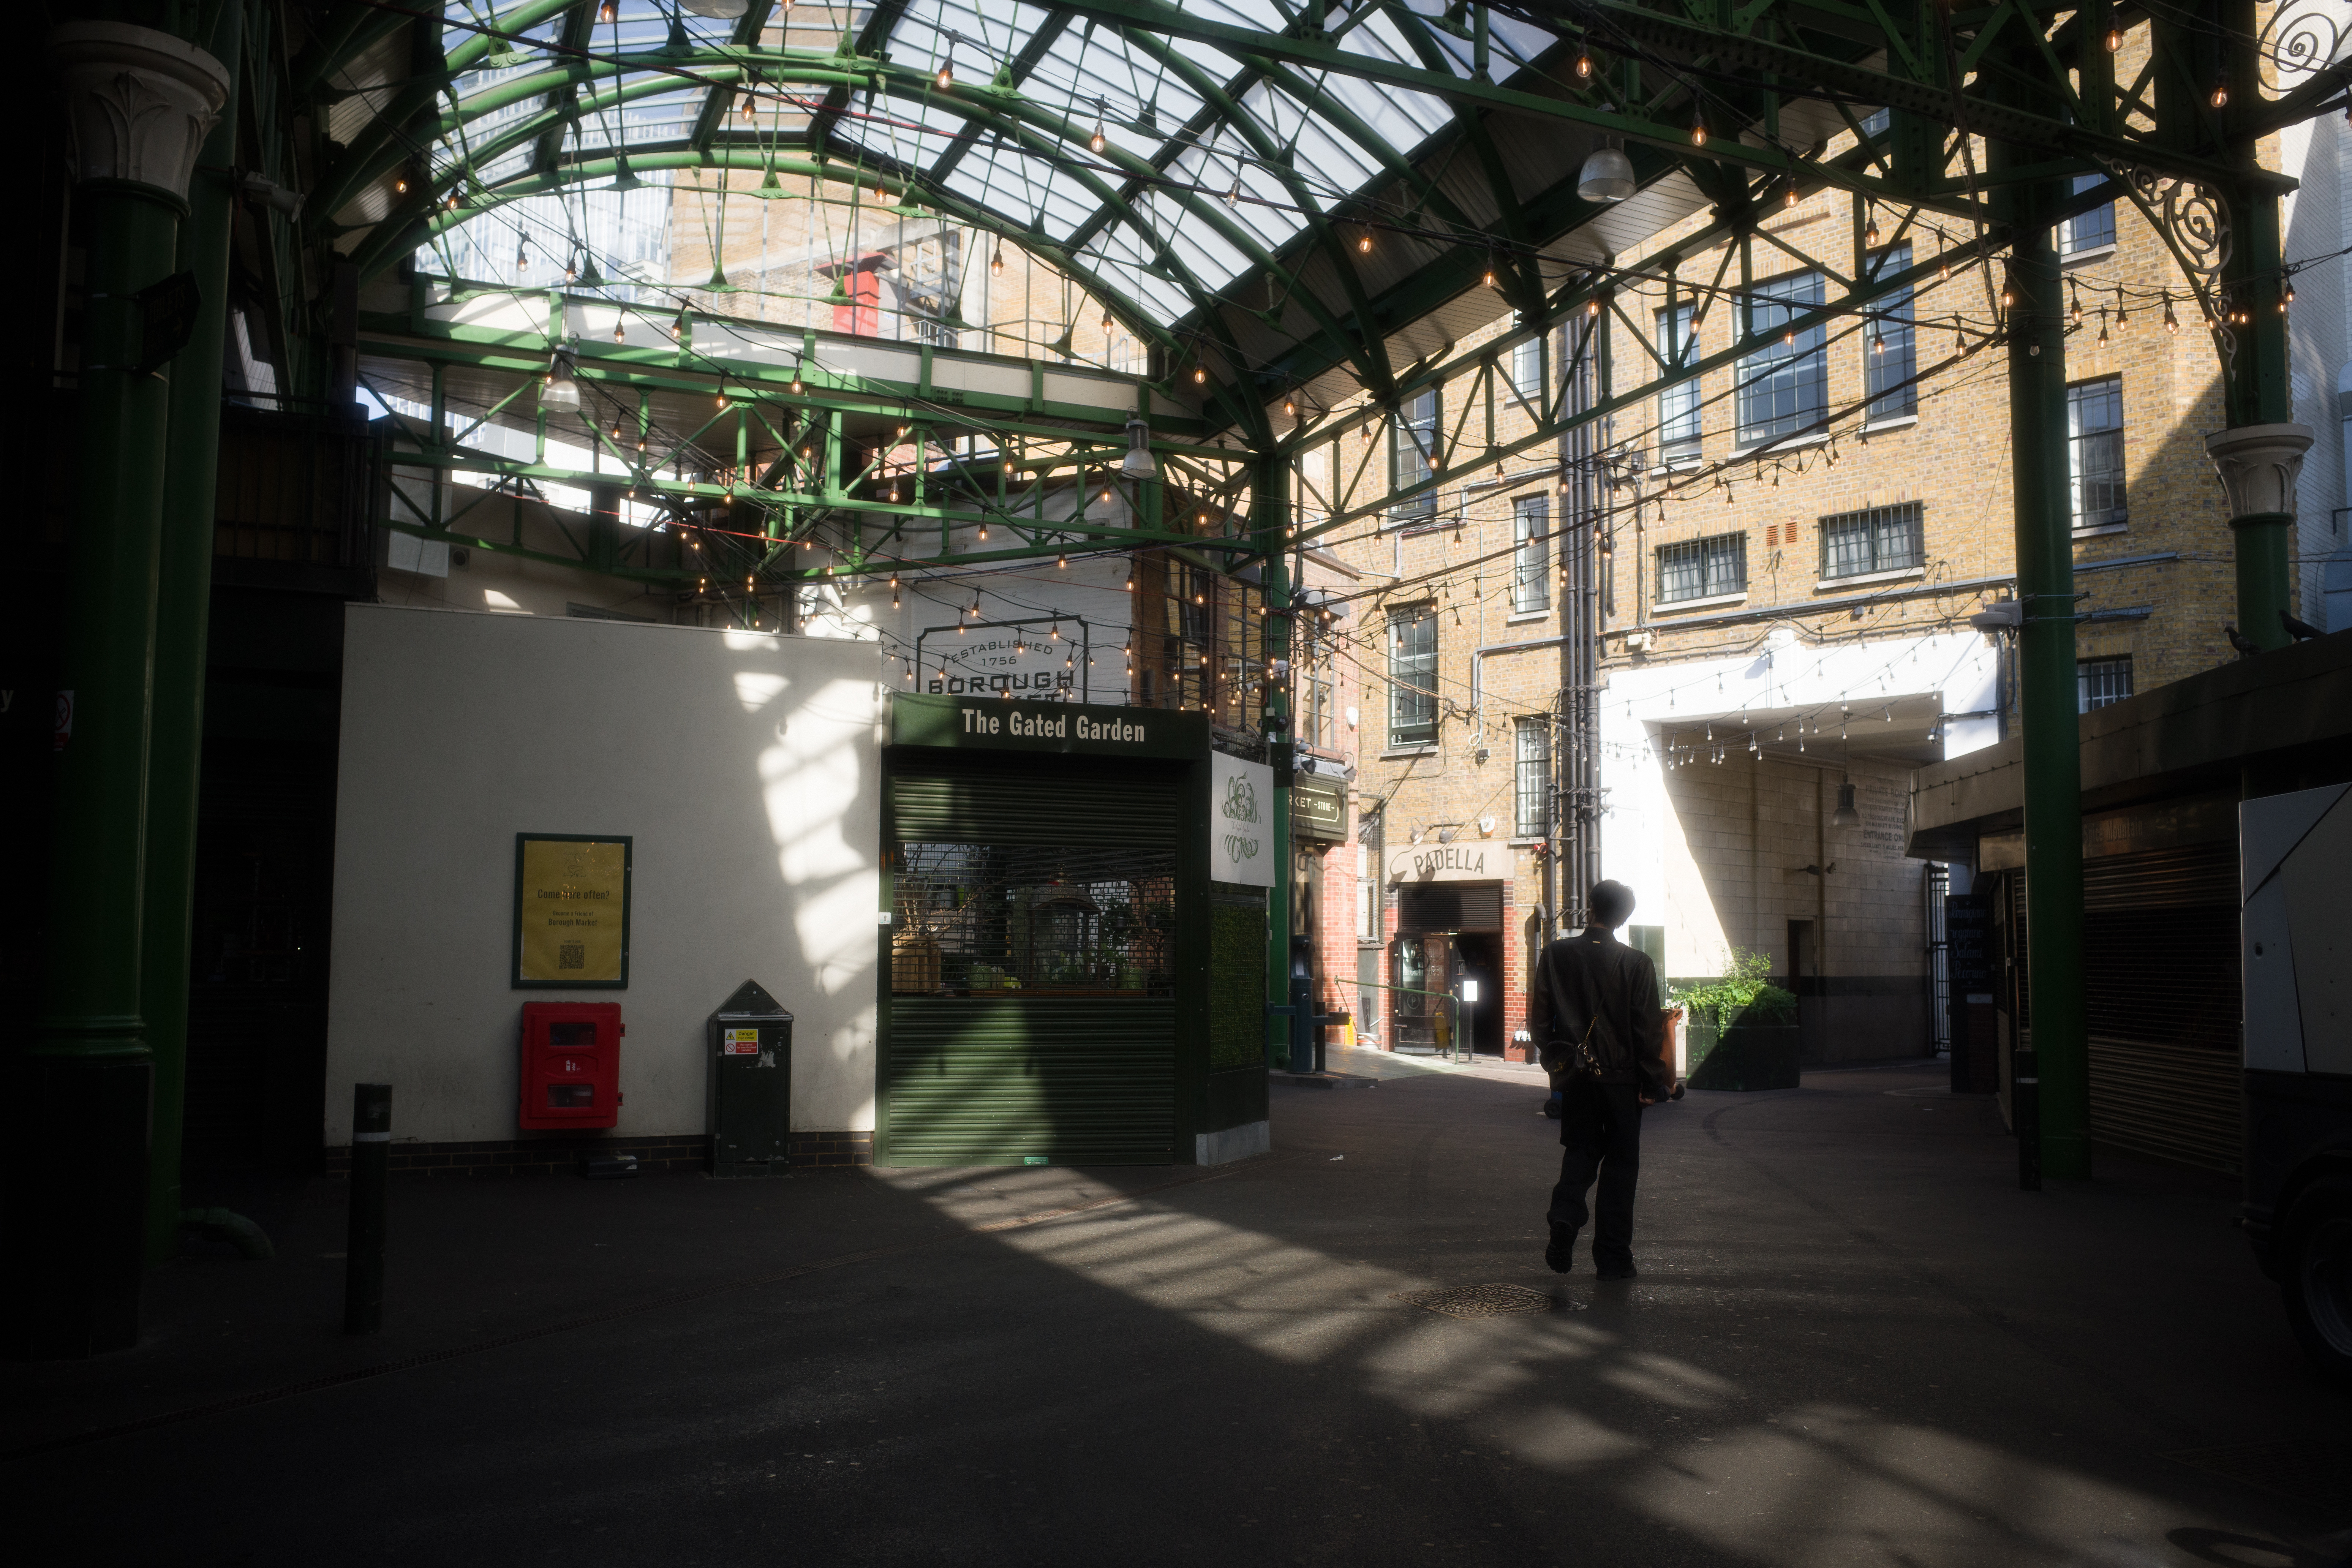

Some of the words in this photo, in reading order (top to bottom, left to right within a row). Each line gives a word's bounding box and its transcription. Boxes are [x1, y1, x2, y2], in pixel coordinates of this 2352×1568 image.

[149, 283, 185, 327] TOILETS
[951, 640, 1053, 664] ESTABLISHED
[982, 656, 1016, 666] 1756
[929, 670, 1073, 694] BOROUGH
[962, 709, 999, 734] The
[1010, 711, 1065, 738] Gated
[1076, 715, 1144, 742] Garden
[1866, 784, 1888, 796] PRIVATE
[1864, 830, 1892, 841] ENTRANCE
[2107, 816, 2143, 840] Mountain
[1413, 848, 1484, 876] PADELLA
[538, 889, 560, 898] Come
[562, 890, 581, 899] here
[584, 890, 610, 899] often?
[1950, 939, 1984, 959] Salami
[1950, 960, 1987, 979] Pecorino
